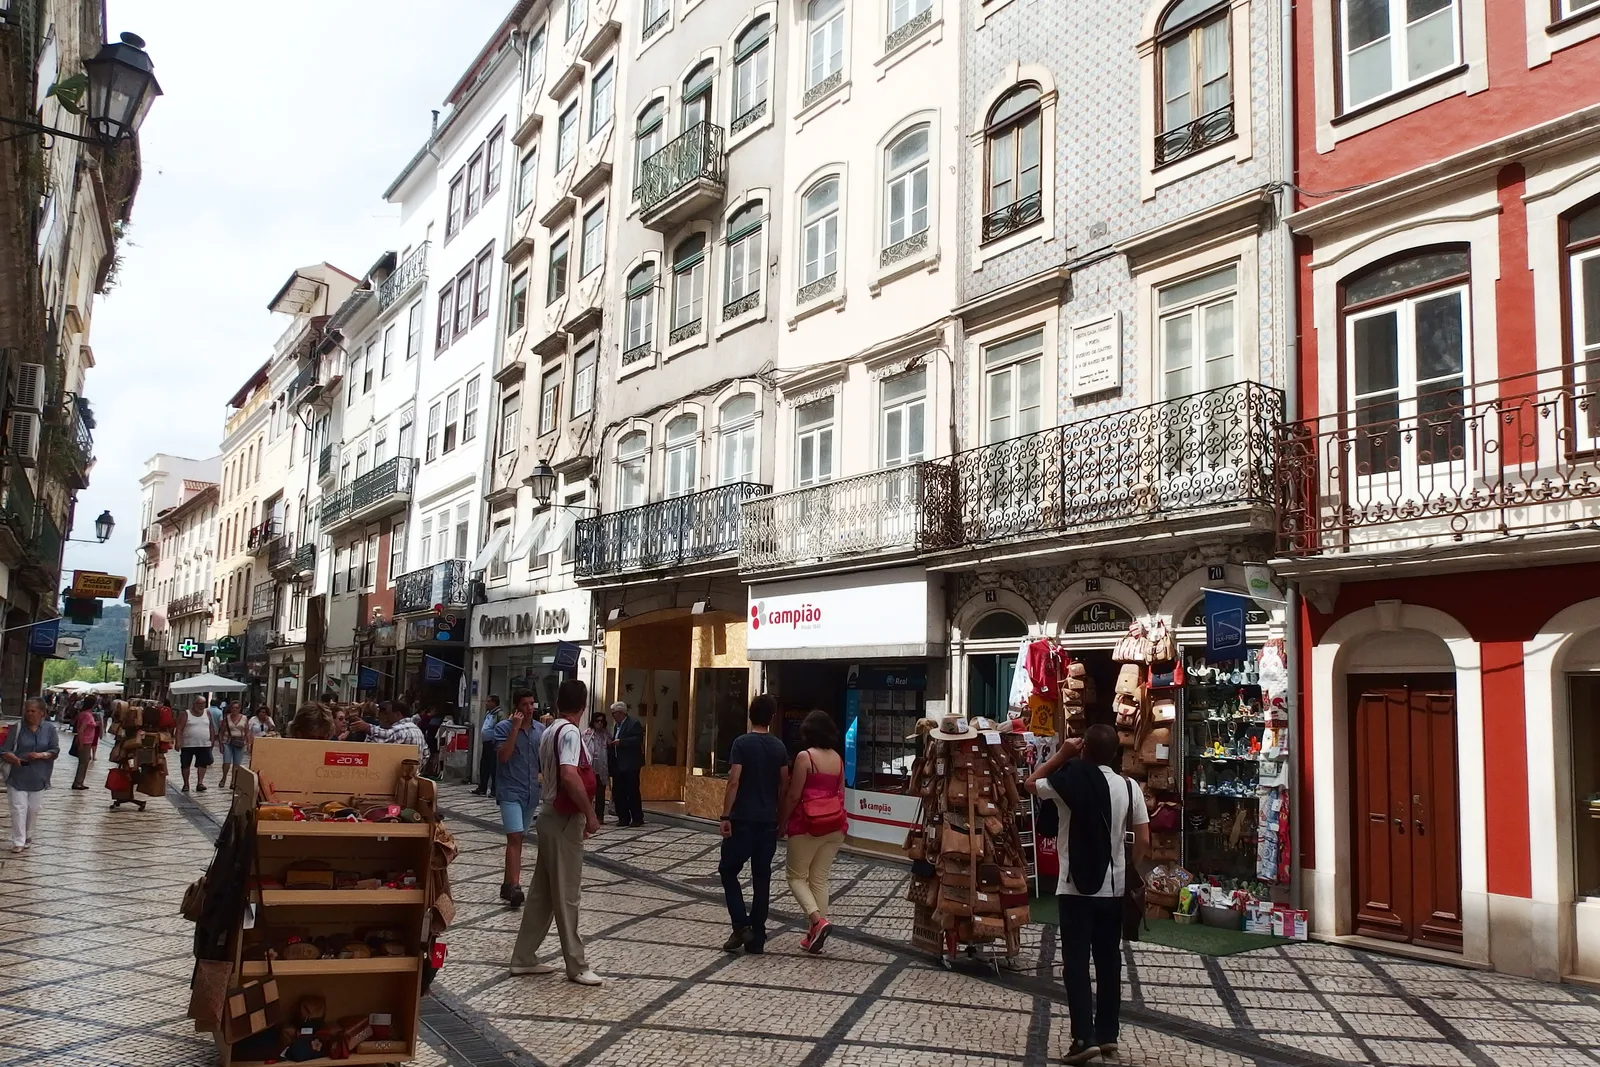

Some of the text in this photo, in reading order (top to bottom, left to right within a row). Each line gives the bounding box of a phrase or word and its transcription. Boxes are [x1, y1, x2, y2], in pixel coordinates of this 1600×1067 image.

[1211, 567, 1222, 579] 70
[1087, 579, 1097, 591] 72
[769, 603, 821, 630] campião
[1074, 621, 1126, 632] HANDICRAFT
[1215, 633, 1239, 643] TAX-FREE
[895, 677, 908, 685] Real
[868, 803, 892, 814] campião
[435, 951, 443, 959] %
